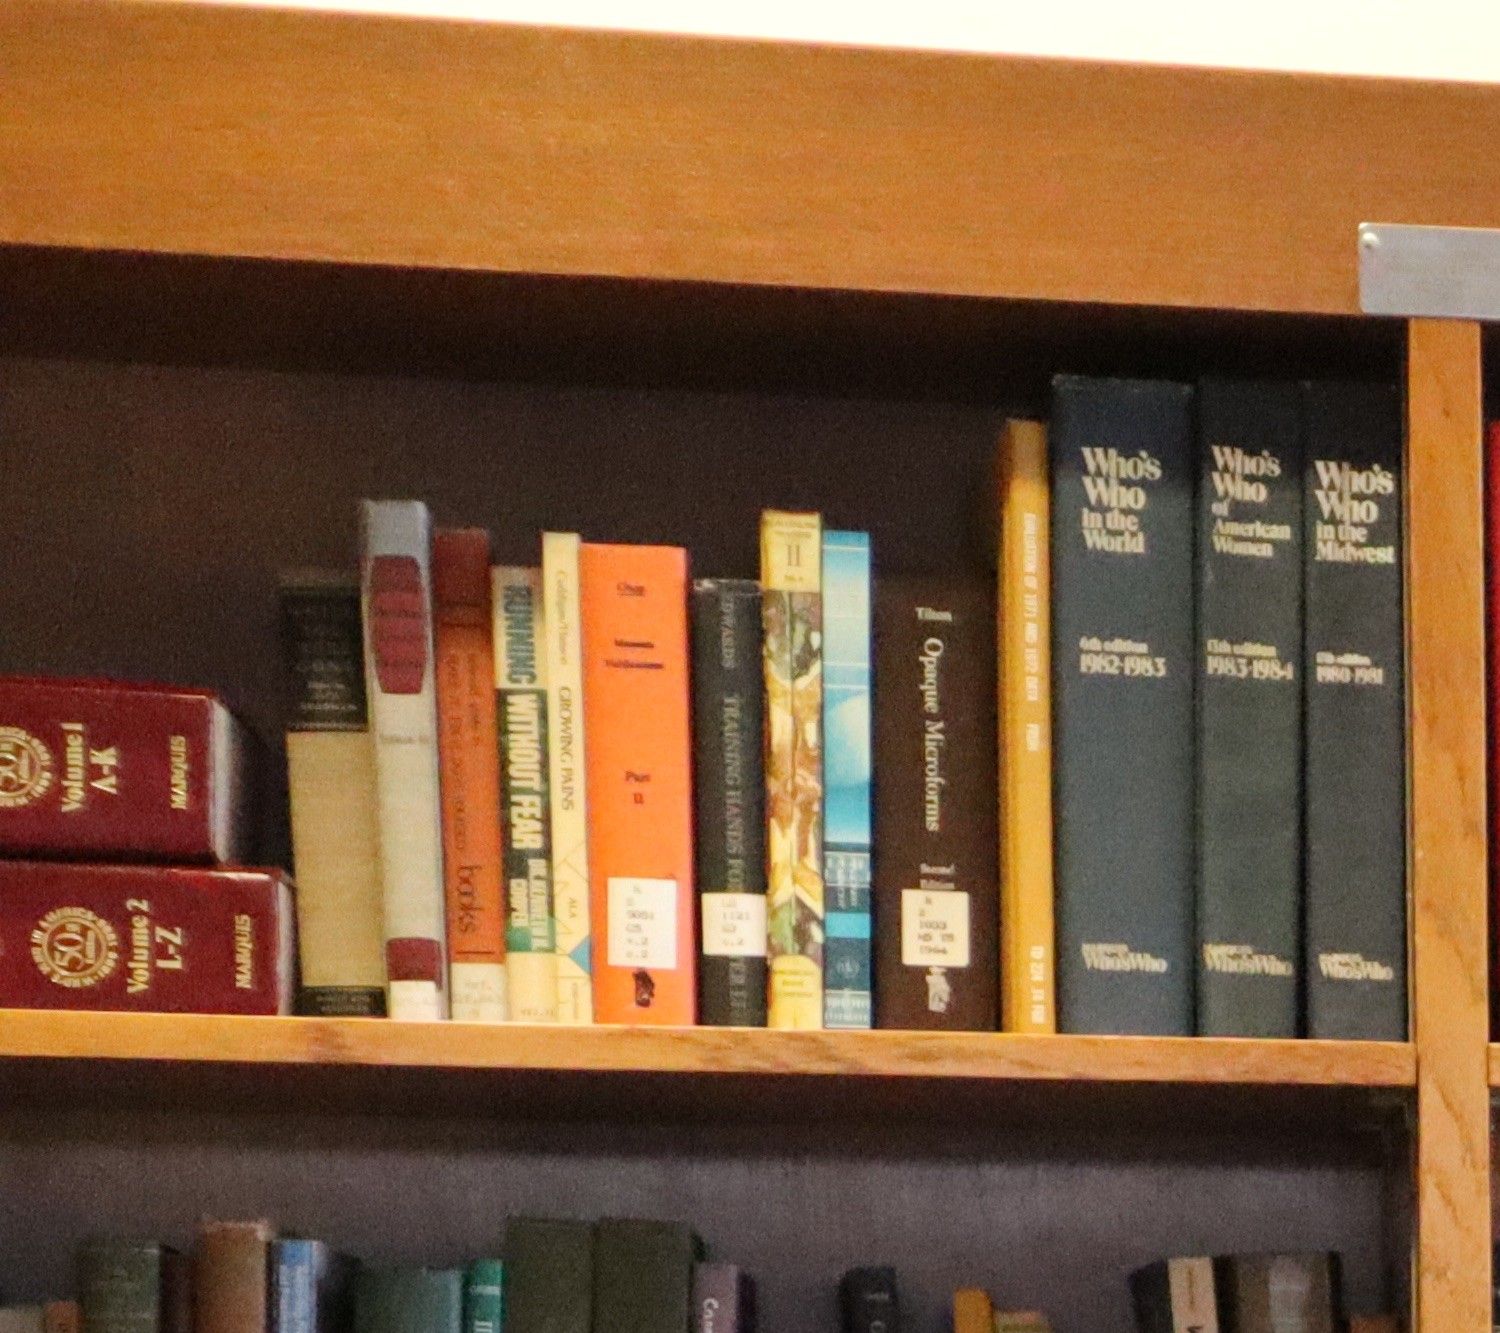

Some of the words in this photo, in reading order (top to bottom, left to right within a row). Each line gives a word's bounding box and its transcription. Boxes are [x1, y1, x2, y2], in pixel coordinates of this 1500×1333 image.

[1081, 445, 1163, 482] Who's
[1211, 444, 1282, 479] Who's
[1314, 459, 1395, 497] Who's
[1081, 473, 1149, 511] Who
[1211, 471, 1269, 505] Who
[1314, 488, 1379, 525] Who
[1104, 508, 1140, 534] the
[1211, 520, 1292, 542] American
[1338, 523, 1369, 545] the
[1082, 529, 1146, 555] World
[1212, 540, 1275, 559] Women
[1314, 539, 1397, 566] Midwest
[918, 637, 945, 714] Opaque
[1079, 652, 1168, 678] 1982-1983
[507, 692, 543, 794] WITHOUT
[559, 686, 575, 763] GROWING
[60, 733, 85, 813] Volume
[90, 745, 118, 796] A-K
[169, 734, 188, 810] MARQUIS
[560, 767, 576, 811] PAINS
[924, 719, 946, 832] Microforms
[510, 796, 545, 850] FEAR
[126, 914, 150, 994] Volume
[155, 926, 183, 970] L-Z
[234, 914, 252, 990] MARQUIS
